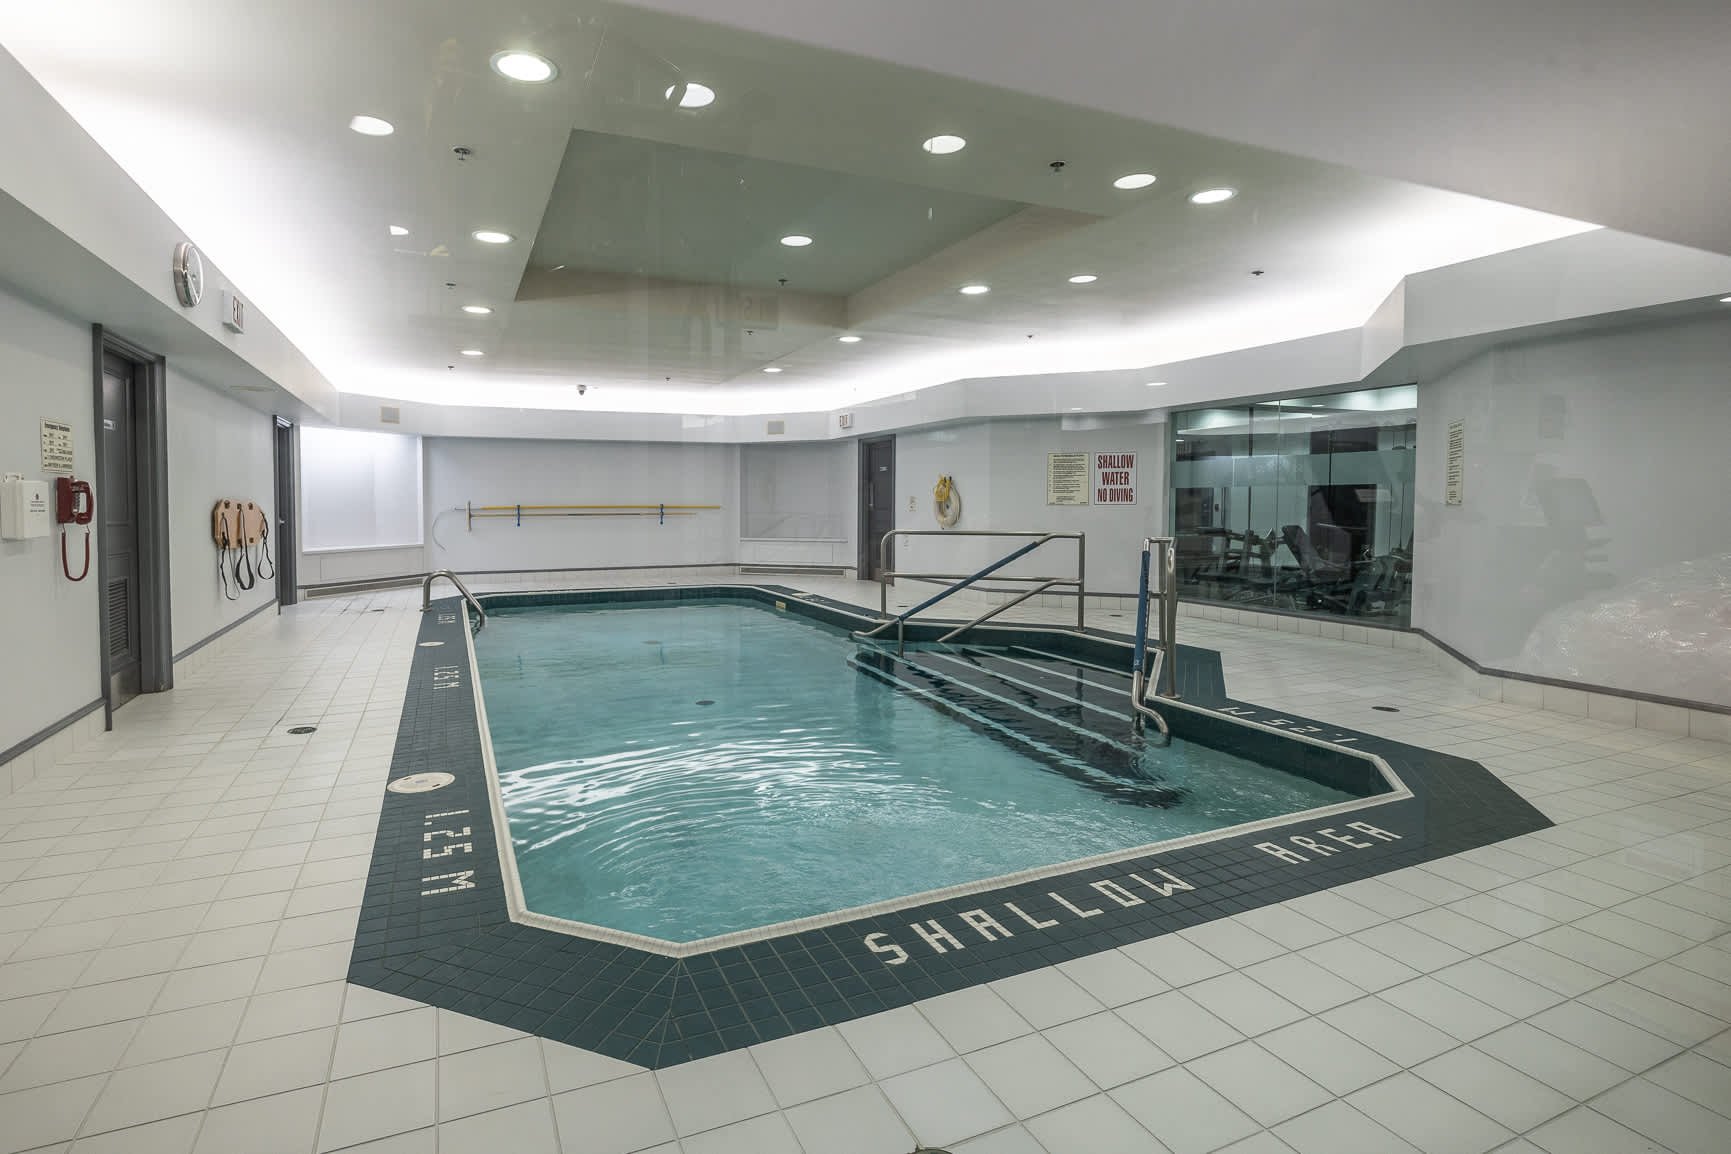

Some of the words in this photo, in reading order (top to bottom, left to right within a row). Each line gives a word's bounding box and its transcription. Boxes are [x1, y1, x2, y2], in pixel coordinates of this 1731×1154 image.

[232, 296, 244, 328] EXIT
[1097, 454, 1135, 469] SHALLOW
[1102, 471, 1130, 486] WATER
[1097, 488, 1108, 502] NO
[1109, 488, 1134, 502] DIVING
[422, 809, 473, 860] 1.25
[421, 869, 476, 896] M
[863, 867, 1197, 966] SHALLOW
[1253, 821, 1403, 865] AREA
